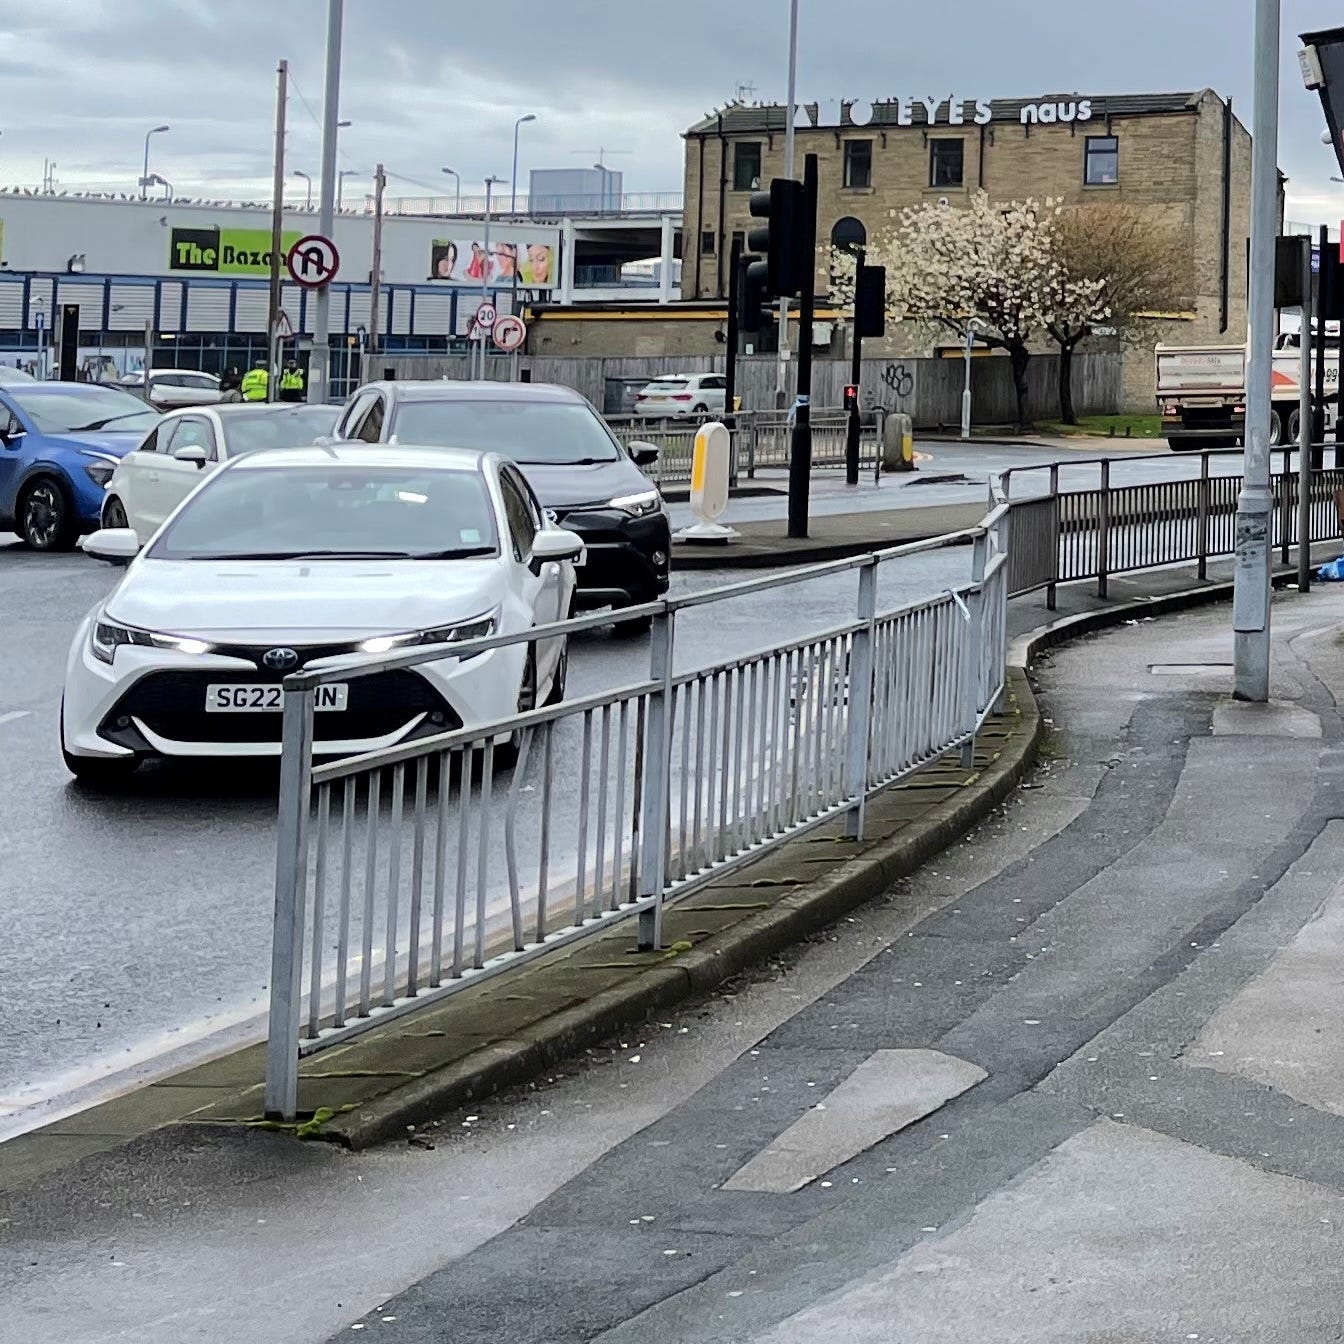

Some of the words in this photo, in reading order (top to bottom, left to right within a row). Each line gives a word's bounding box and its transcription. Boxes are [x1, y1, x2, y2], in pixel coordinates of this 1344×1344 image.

[897, 96, 992, 126] EYES
[177, 242, 217, 265] The
[481, 309, 494, 320] 20
[216, 687, 281, 707] SG22
